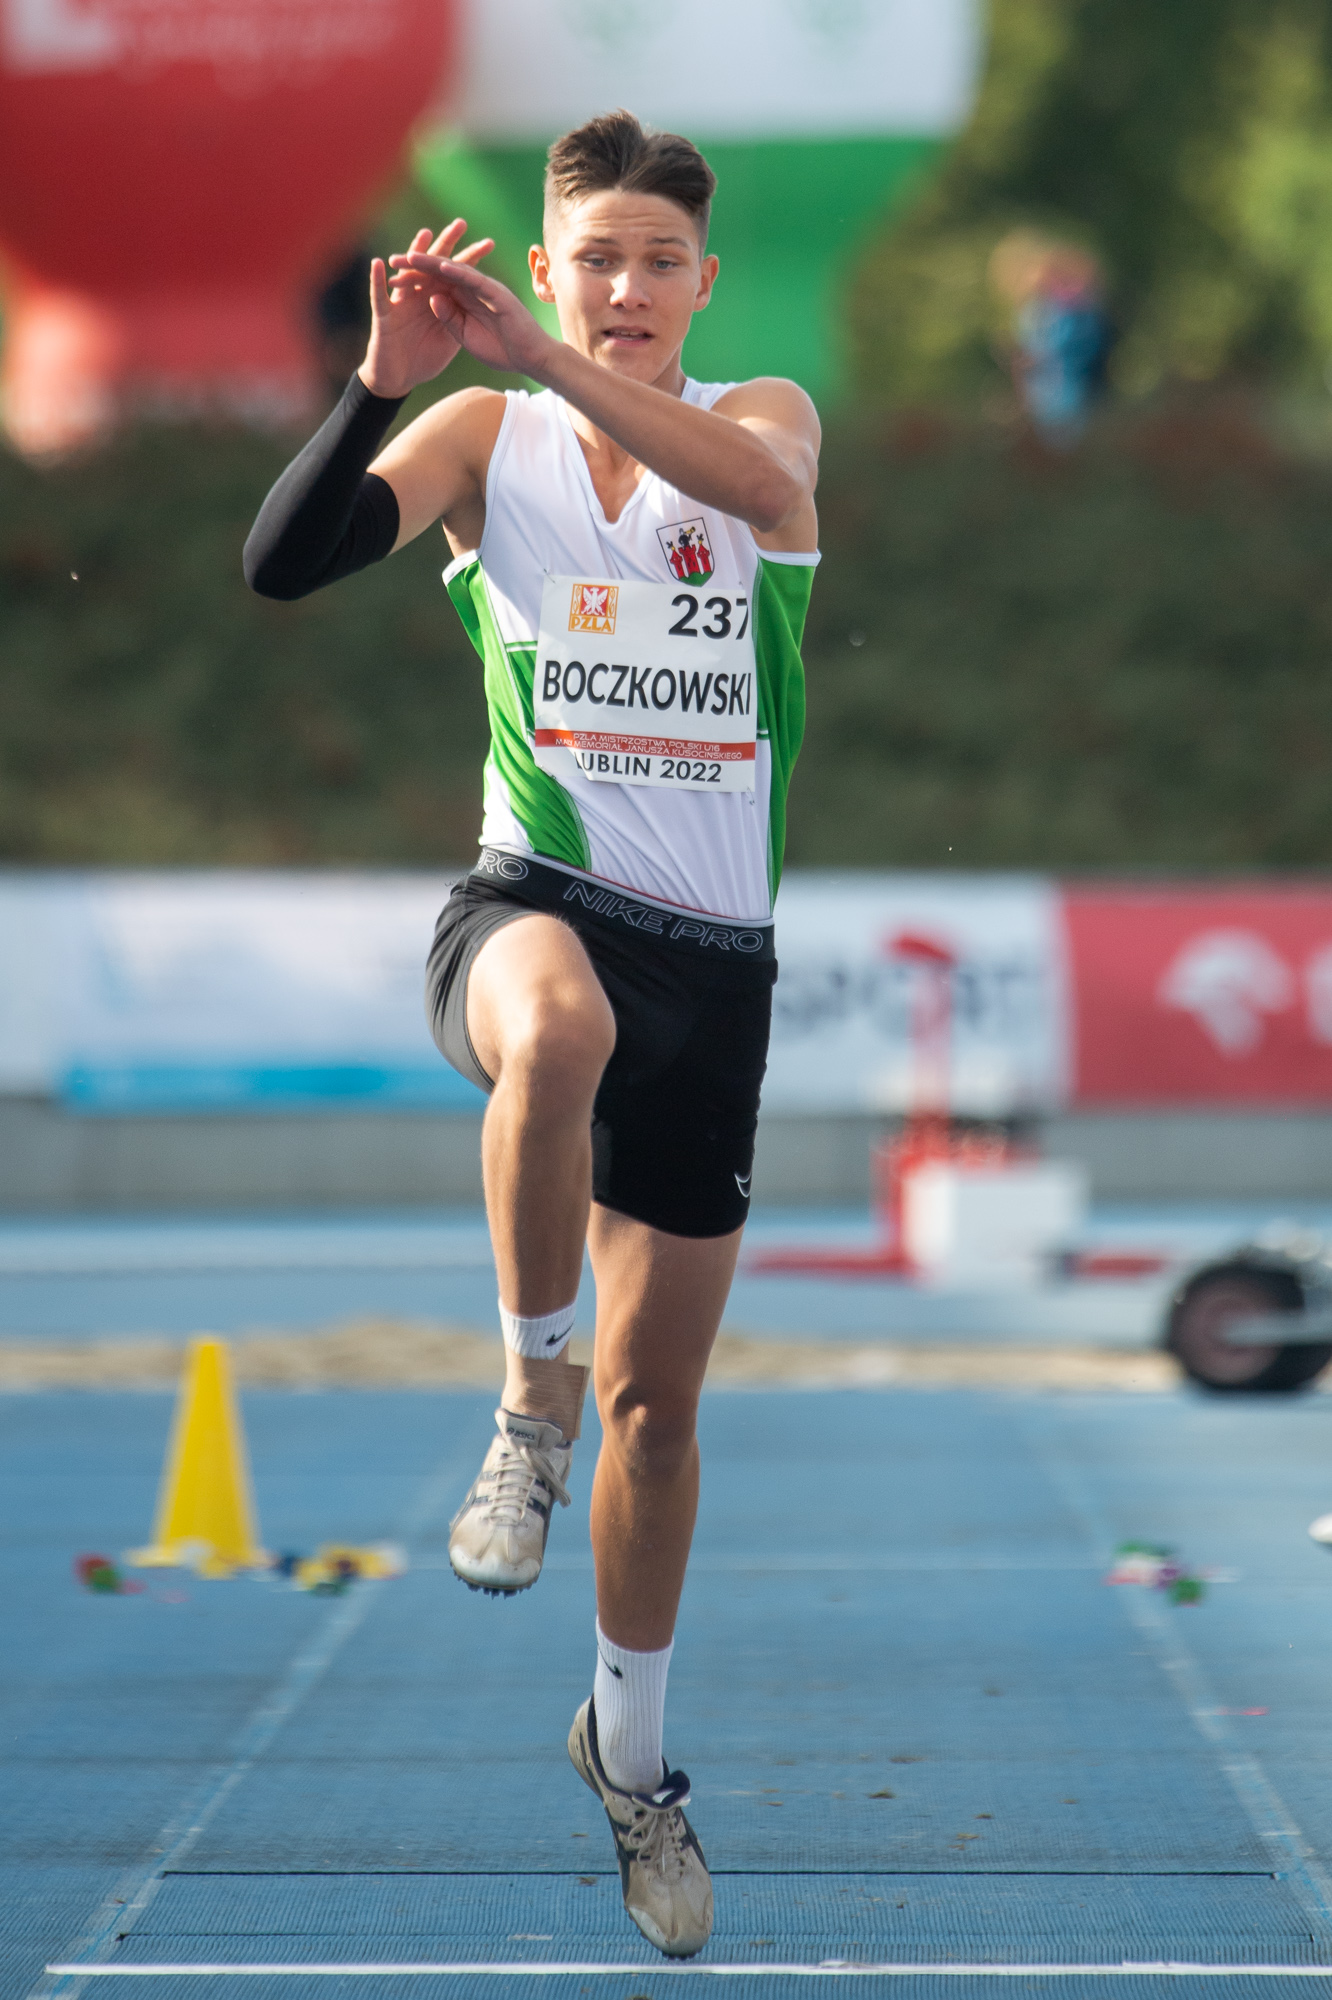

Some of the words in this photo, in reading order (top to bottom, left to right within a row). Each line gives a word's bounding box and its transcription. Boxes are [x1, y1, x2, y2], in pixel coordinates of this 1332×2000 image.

[570, 615, 612, 632] PZLA
[668, 593, 749, 640] 237
[542, 660, 752, 716] BOCZKOWSKI
[573, 733, 597, 741] PZLA
[599, 735, 667, 748] MISTRZOSTWA
[668, 741, 702, 750] POLSKI
[625, 744, 670, 755] JANUSZA
[660, 759, 722, 783] 2022
[563, 881, 672, 934] NIKE
[670, 918, 763, 953] PRO
